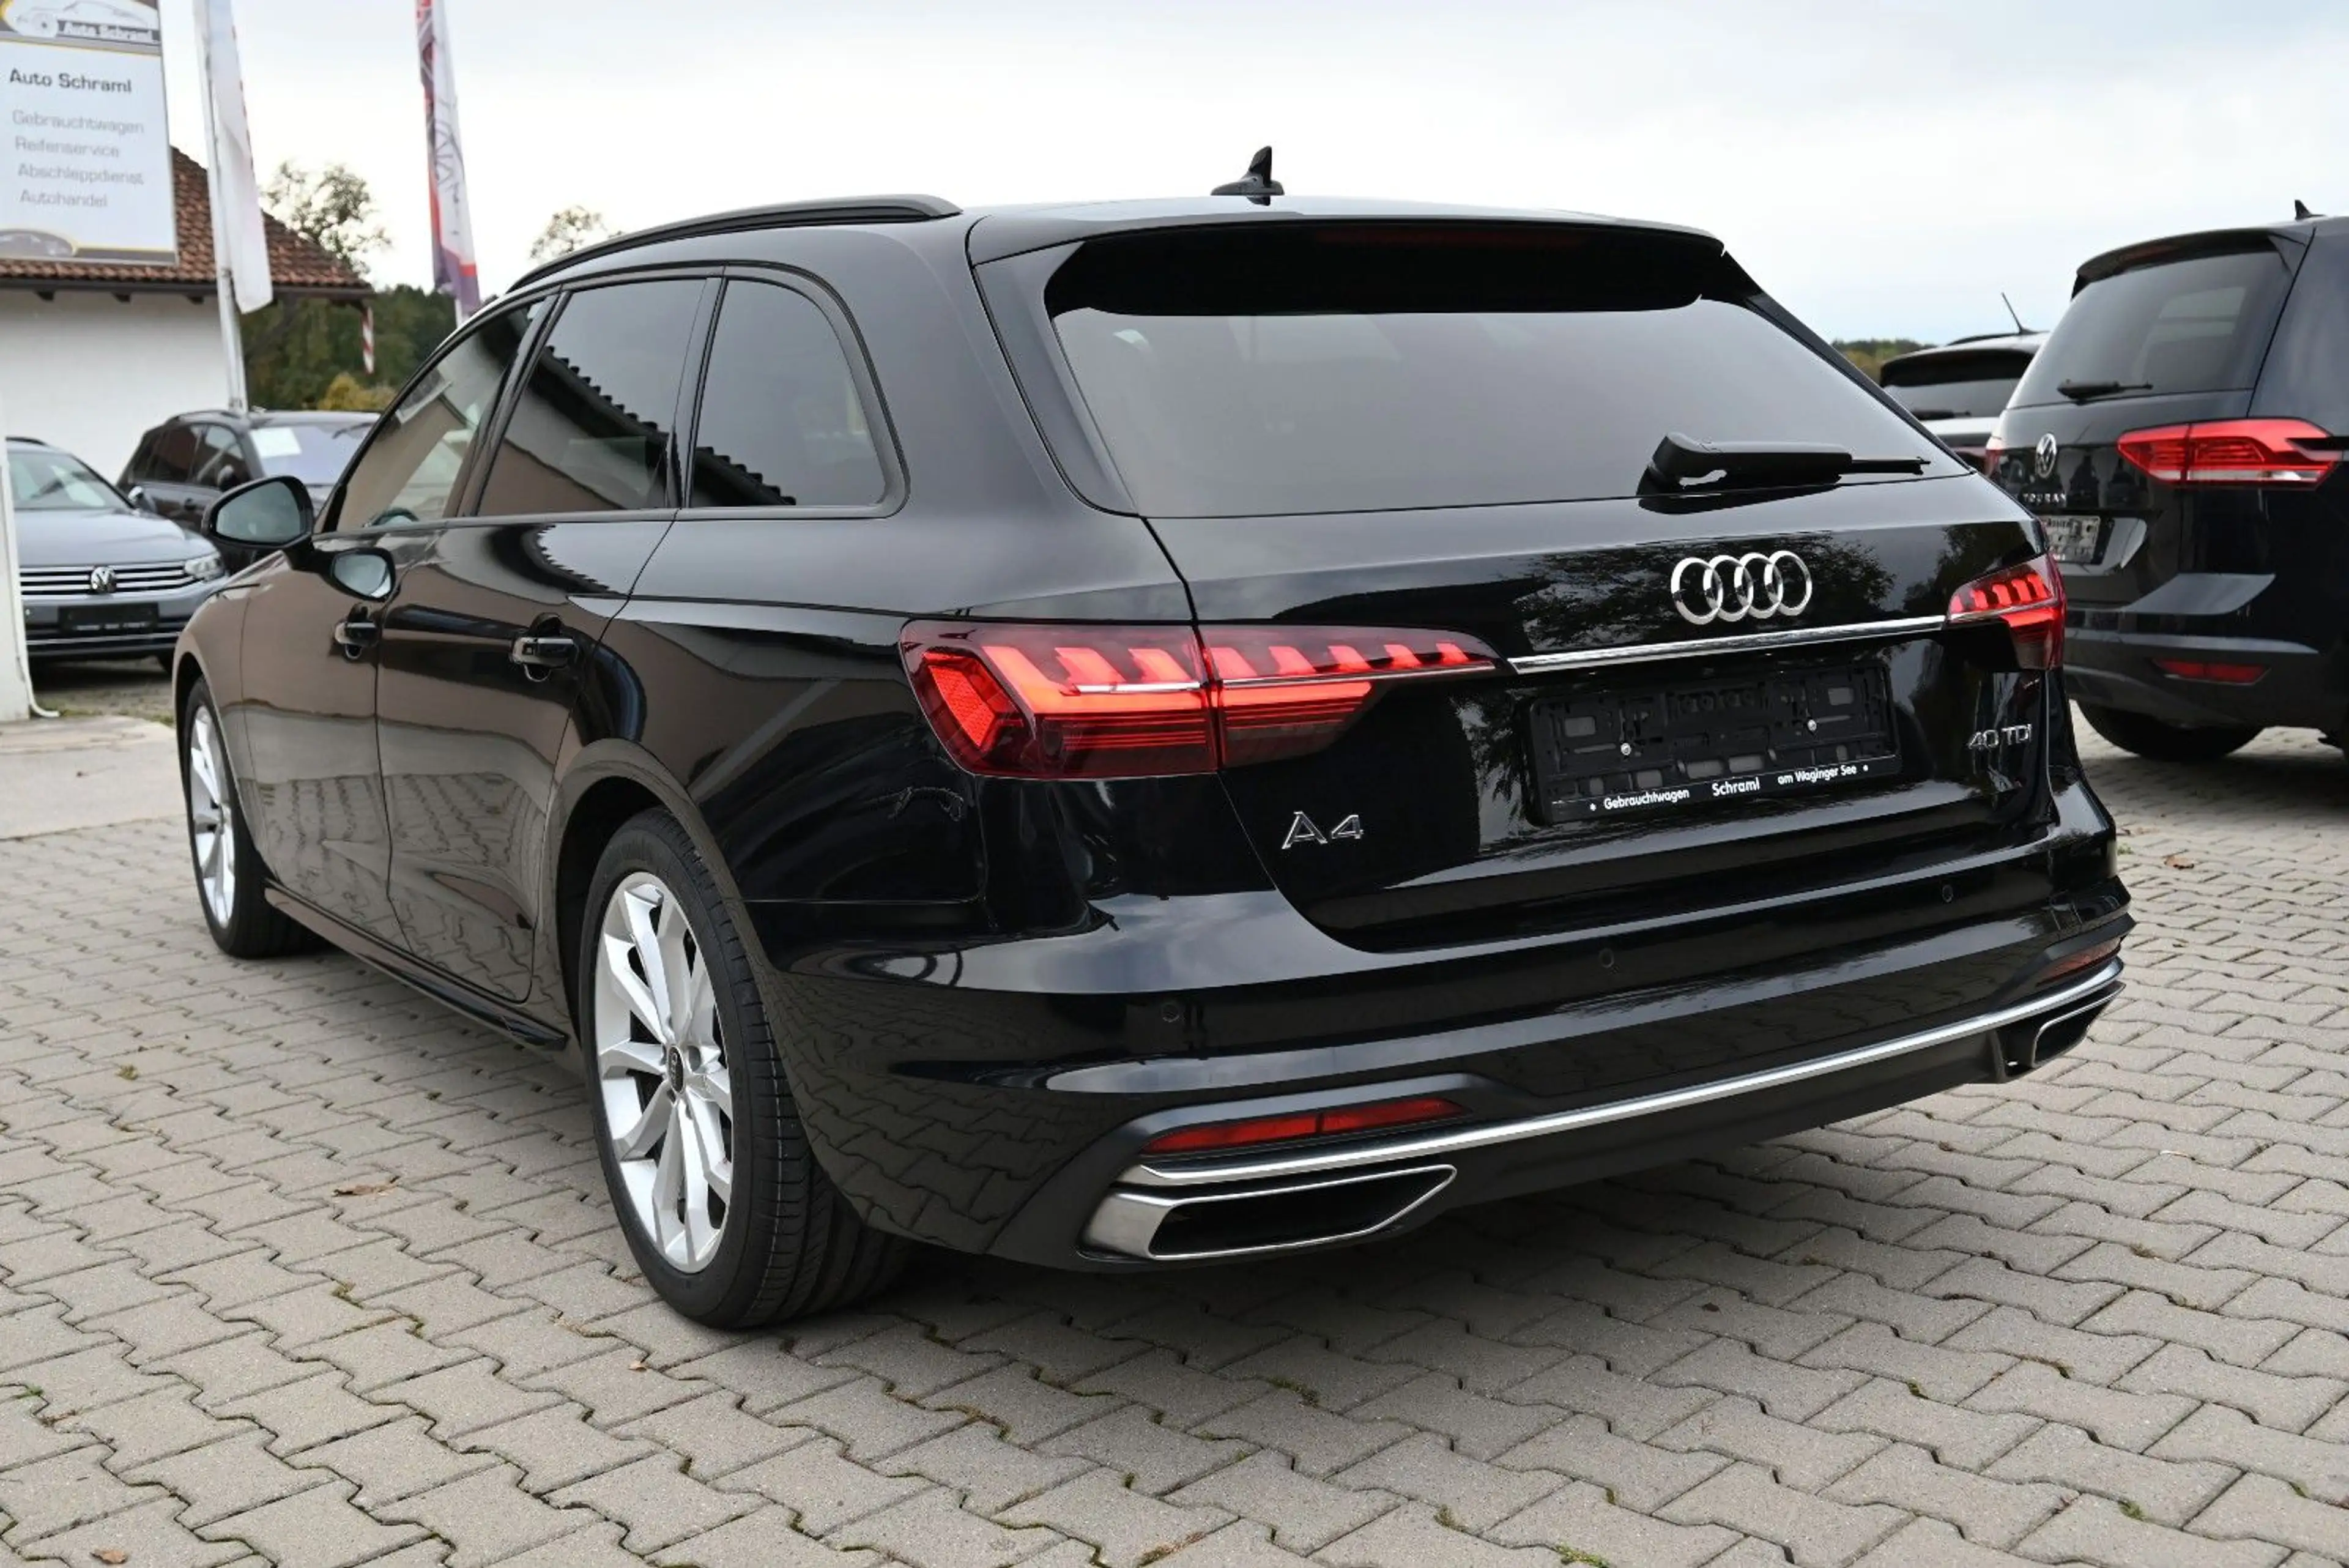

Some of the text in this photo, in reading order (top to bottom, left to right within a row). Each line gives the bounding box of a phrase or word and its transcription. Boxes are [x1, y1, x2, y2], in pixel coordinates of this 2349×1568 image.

[10, 68, 132, 93] Auto Schraml
[12, 109, 144, 135] Gebrauchtwagen
[15, 135, 120, 158] Reifenservice
[18, 163, 145, 185] Abschleppdienst
[19, 188, 108, 209] Autohandel
[1966, 723, 2033, 751] 40 TDI
[1604, 765, 1857, 810] Gebrauchtwagen Schraml am Waginger See
[1282, 810, 1364, 849] A4
